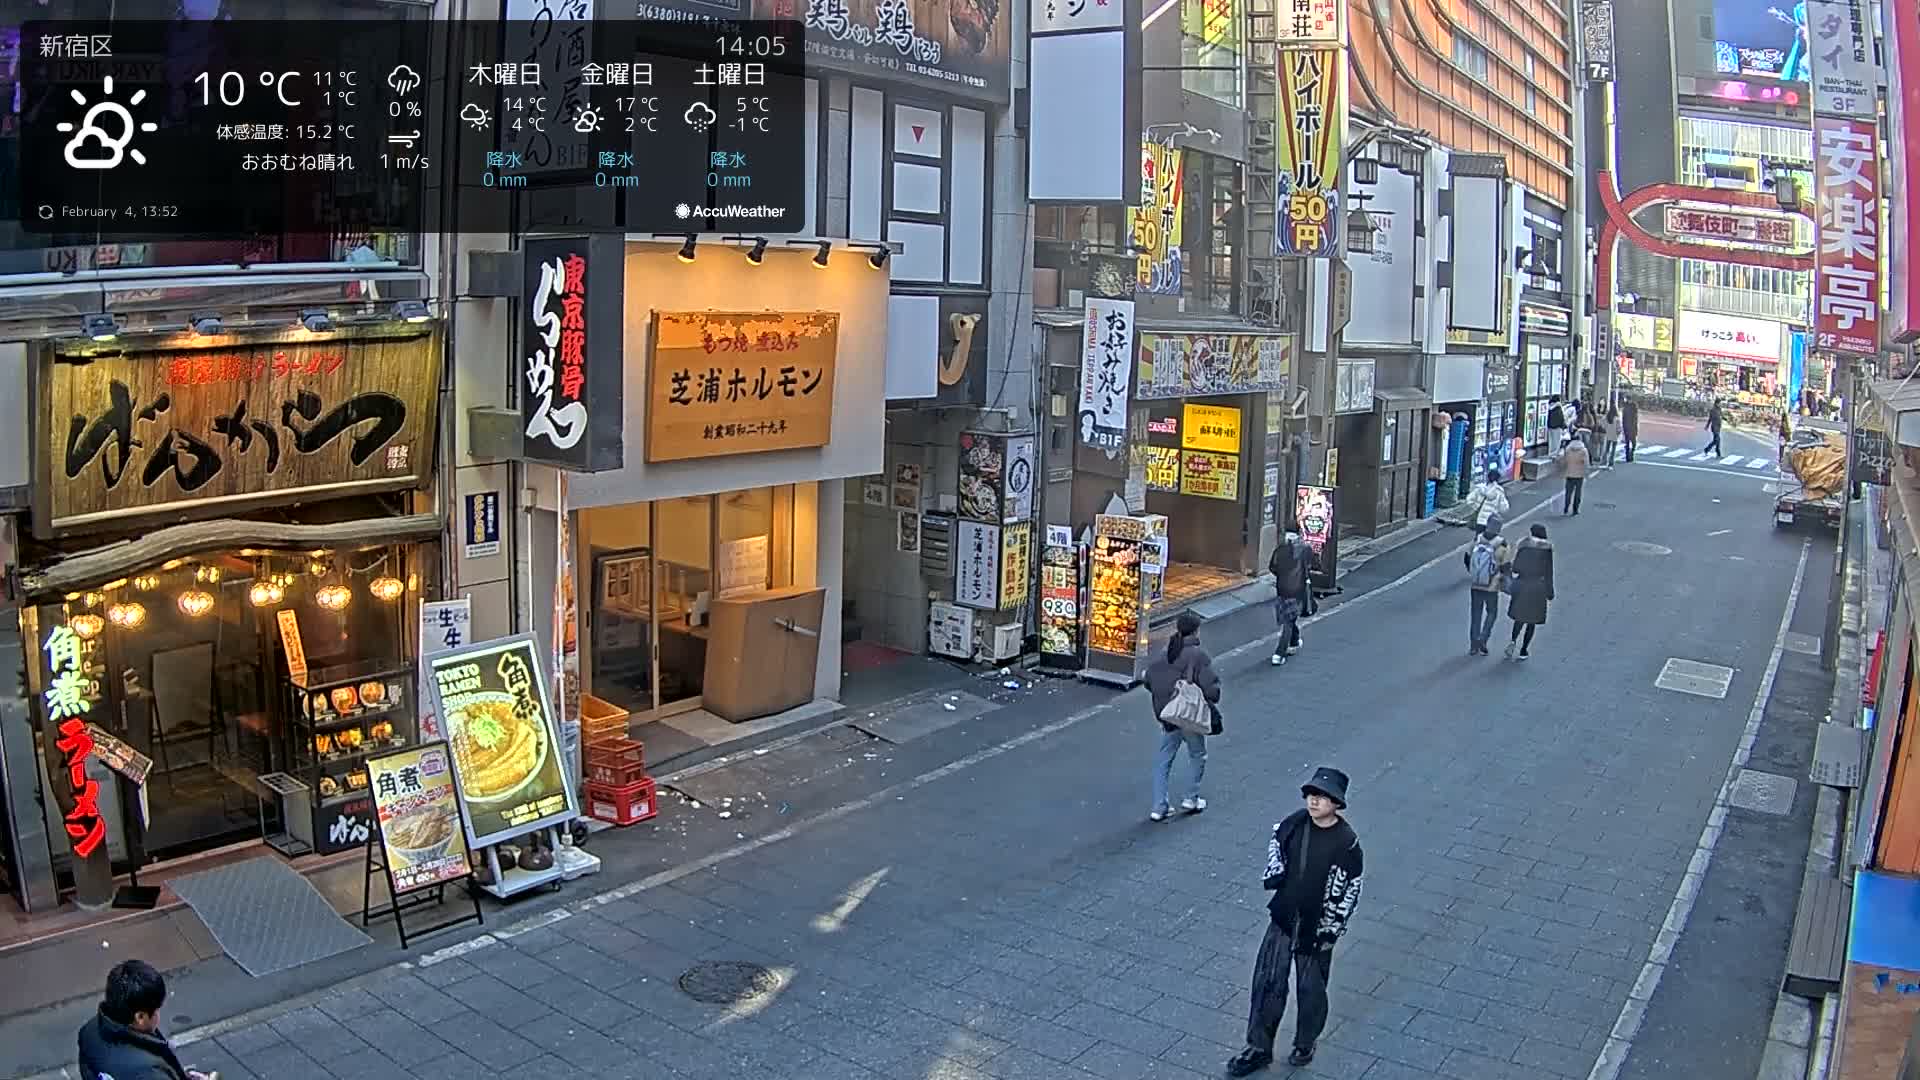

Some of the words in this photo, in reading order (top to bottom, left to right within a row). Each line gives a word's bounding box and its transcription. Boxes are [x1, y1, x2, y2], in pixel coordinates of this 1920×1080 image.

[1817, 13, 1844, 71] タイ
[1589, 63, 1610, 79] 7F
[1296, 51, 1321, 190] ハイボール
[1832, 97, 1856, 112] 3F
[1289, 195, 1327, 221] 50
[1296, 224, 1319, 250] 円
[1670, 210, 1792, 242] 歌舞伎町一番街
[1819, 126, 1876, 330] 安楽亭
[560, 252, 586, 401] 東京豚骨
[1818, 333, 1837, 347] 2F
[1097, 309, 1128, 415] お好み焼き
[668, 365, 824, 406] 芝浦ホルモン
[703, 419, 789, 440] 創業昭和二十九年
[1099, 432, 1123, 447] B1F
[1050, 530, 1069, 546] 4階
[972, 527, 983, 601] 芝浦ホルモン
[1043, 598, 1076, 617] 980
[43, 626, 90, 721] 角煮
[435, 663, 480, 684] TOKYO
[439, 676, 482, 696] RAMEN
[499, 655, 538, 719] 角煮
[56, 718, 106, 857] ラーメン
[376, 765, 421, 798] 角煮
